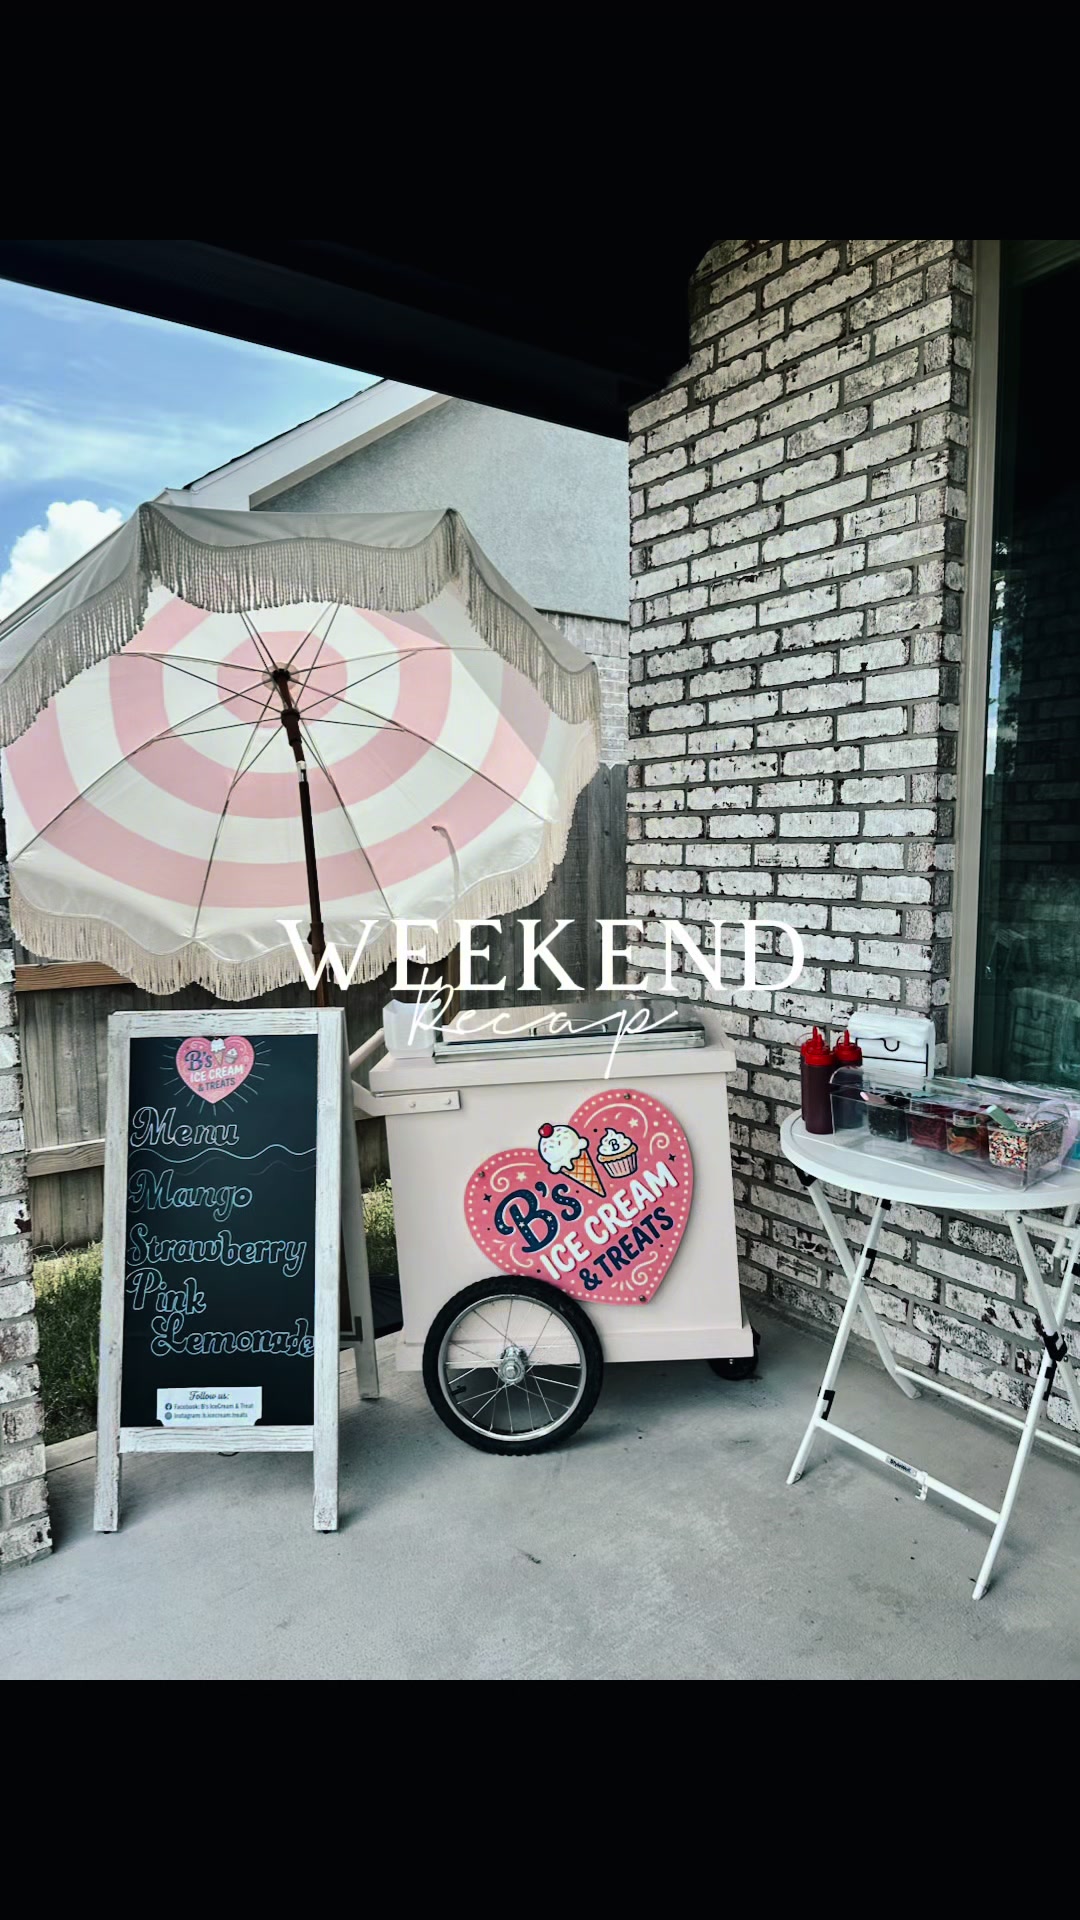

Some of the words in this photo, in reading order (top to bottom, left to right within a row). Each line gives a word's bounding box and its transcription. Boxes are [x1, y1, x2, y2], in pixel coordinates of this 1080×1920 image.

[185, 1050, 213, 1071] B's
[190, 1070, 207, 1083] ICE
[208, 1064, 244, 1080] CREAM
[198, 1083, 204, 1091] &
[205, 1077, 236, 1091] TREATS
[130, 1106, 240, 1147] Menu
[608, 1138, 620, 1151] B
[128, 1169, 253, 1222] Mango
[494, 1181, 585, 1253] B's
[539, 1231, 591, 1281] ICE
[584, 1161, 679, 1245] CREAM
[126, 1223, 307, 1278] Strawberry
[579, 1267, 603, 1291] &
[593, 1206, 674, 1278] TREATS
[125, 1267, 207, 1315] Pink
[151, 1311, 315, 1357] Lemonade
[189, 1391, 216, 1401] Follow
